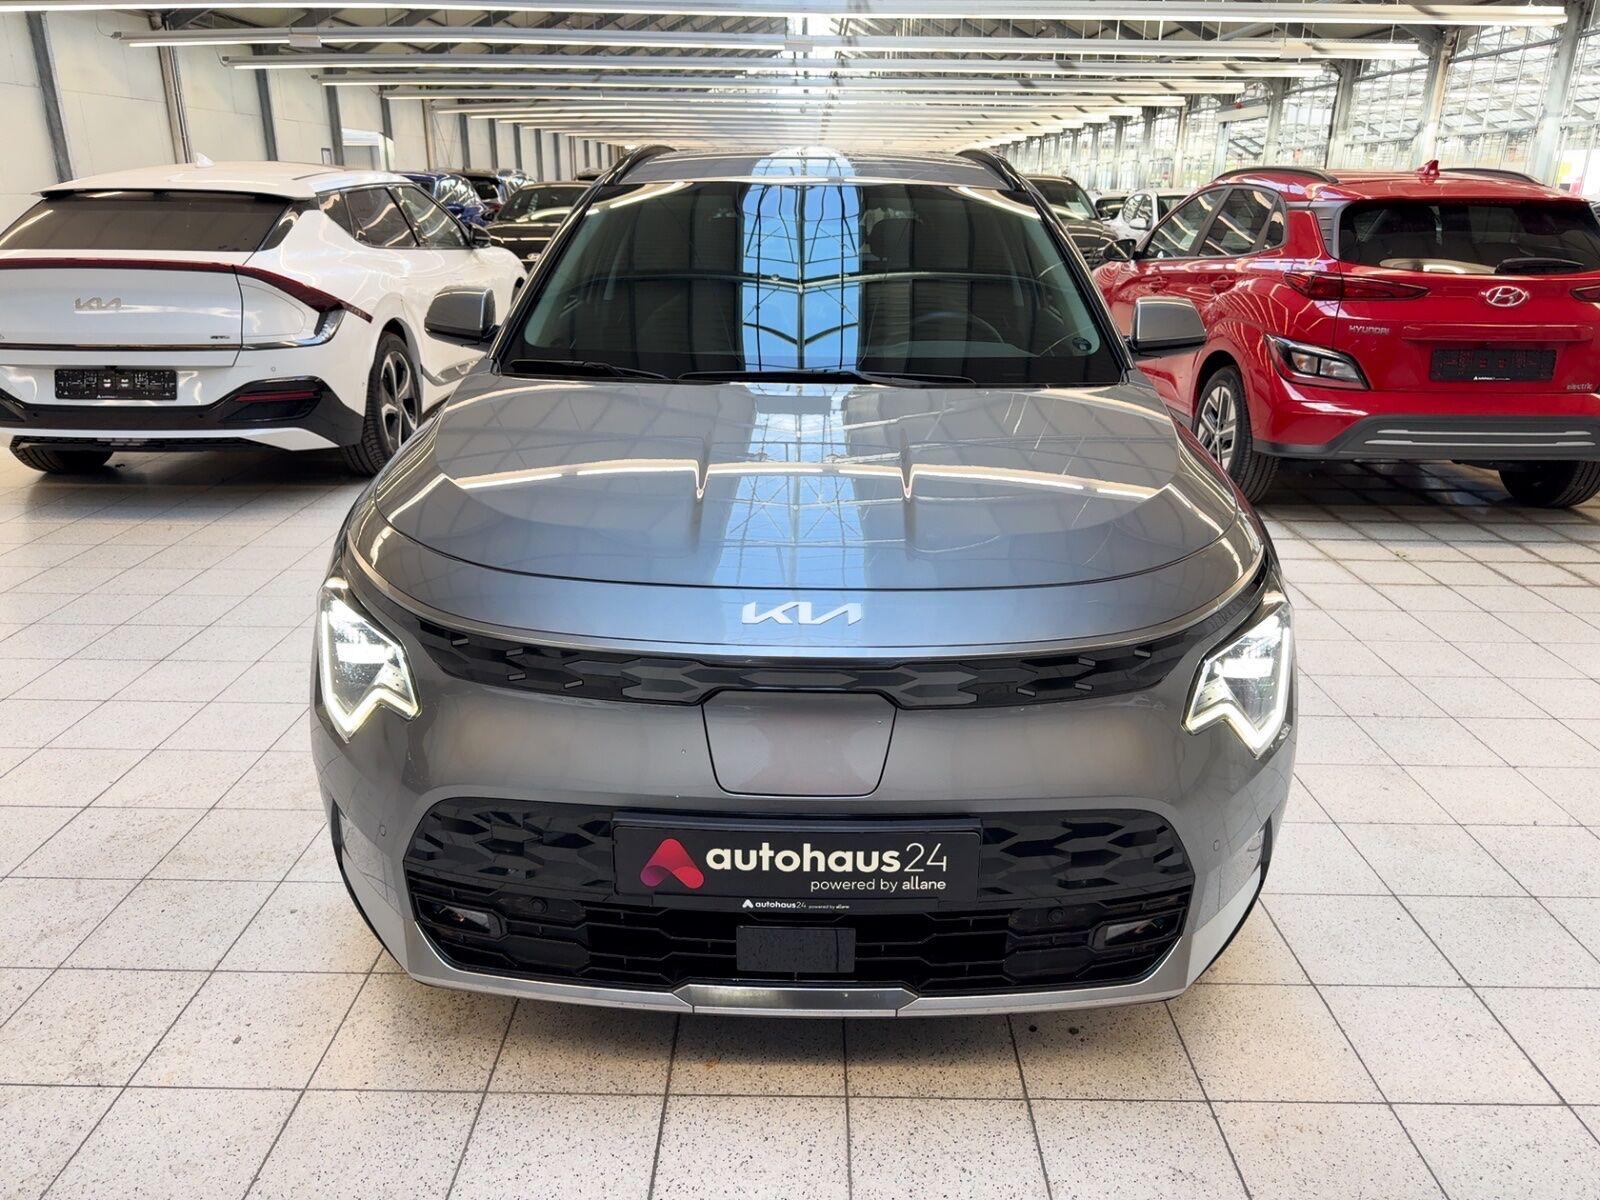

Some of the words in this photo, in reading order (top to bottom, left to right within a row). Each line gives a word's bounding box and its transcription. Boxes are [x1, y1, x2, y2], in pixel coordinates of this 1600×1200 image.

[74, 297, 122, 310] KIA
[1349, 325, 1390, 335] HYUNDAI
[741, 601, 862, 626] KIA
[705, 842, 947, 873] autohaus24
[810, 876, 876, 892] powered
[879, 876, 898, 893] by
[901, 874, 947, 891] allane
[755, 901, 807, 909] autohaus24
